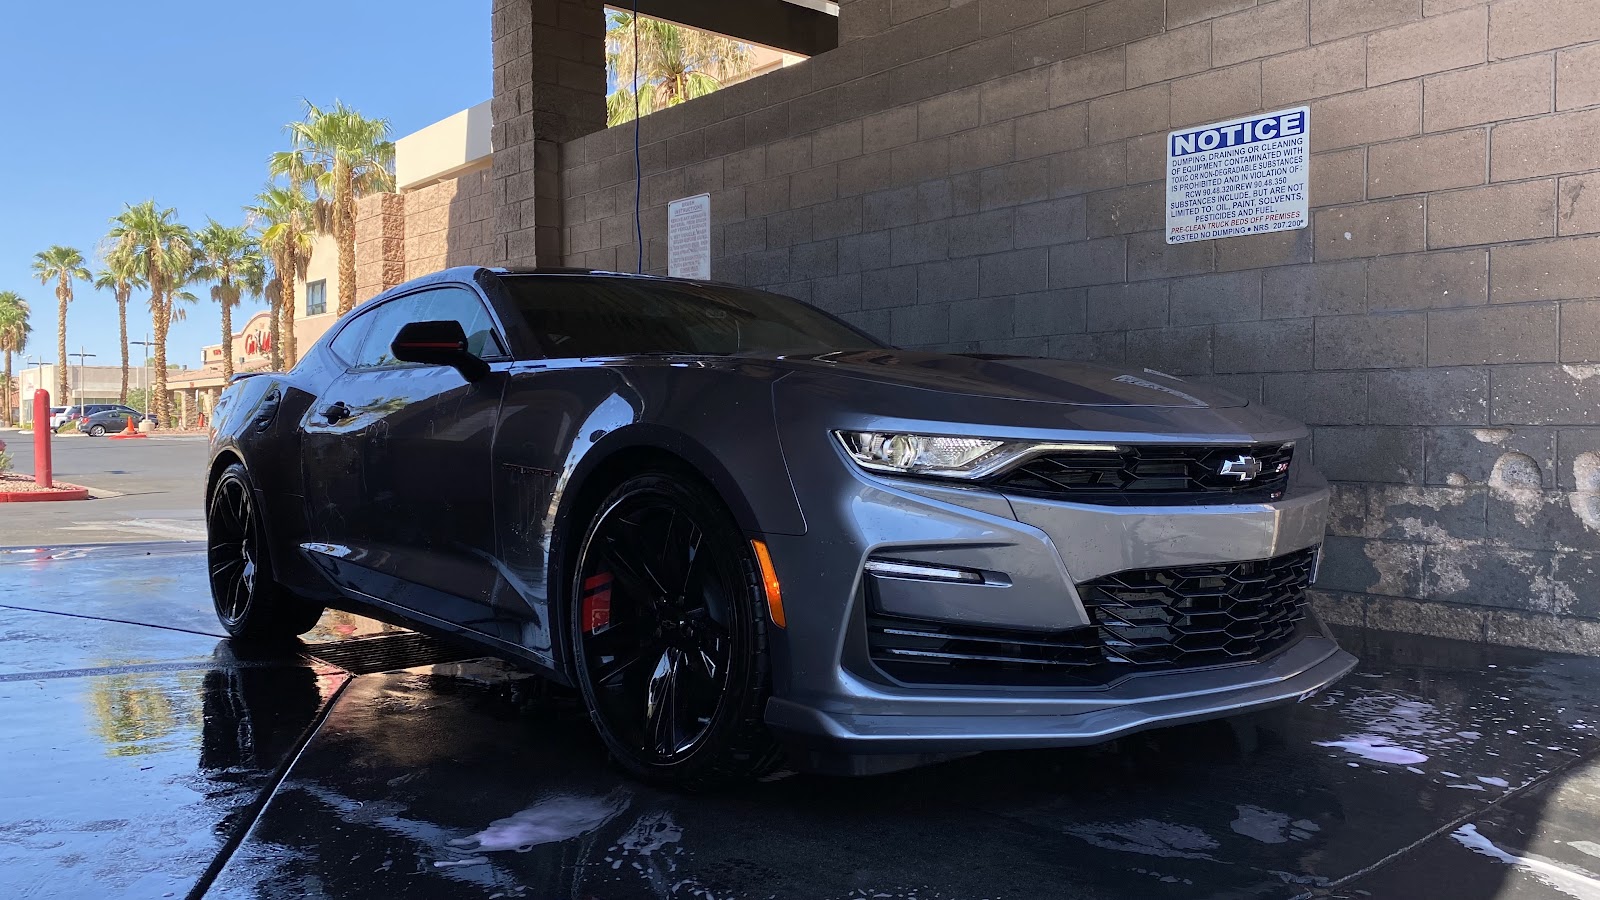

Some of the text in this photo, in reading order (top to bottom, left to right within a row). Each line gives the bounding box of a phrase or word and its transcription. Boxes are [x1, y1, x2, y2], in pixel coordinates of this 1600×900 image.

[1174, 113, 1301, 156] NOTICE
[1171, 146, 1303, 176] OF EQUIPMENT CONTAMINATED WITH
[1172, 137, 1303, 167] DUMPING, DRAINING OR CLEANING
[1171, 155, 1303, 184] TOXIC OR NON-DEGRADABLE SUBSTANCES
[1180, 178, 1222, 191] PROHIBITED
[1223, 175, 1240, 184] AND
[1241, 173, 1249, 181] IN
[1249, 167, 1288, 179] VIOLATION
[1170, 196, 1216, 210] SUBSTANCES
[1253, 188, 1268, 197] BUT
[1269, 186, 1286, 195] ARE
[1287, 183, 1305, 192] NOT
[1185, 190, 1202, 199] RCW
[1253, 176, 1287, 188] 90.48.350
[674, 204, 703, 215] INSTRUCTIONS
[1171, 206, 1200, 218] LIMITED
[1201, 205, 1214, 213] TO:
[1258, 192, 1304, 206] SOLVENTS,
[1195, 209, 1236, 223] PESTICIDES
[1237, 207, 1254, 216] AND
[1171, 211, 1300, 234] PRE-CLEAN TRUCK BEDS OFF PREMISES
[1200, 230, 1211, 238] NO
[1212, 226, 1246, 237] DUMPING
[1253, 223, 1269, 232] NRS
